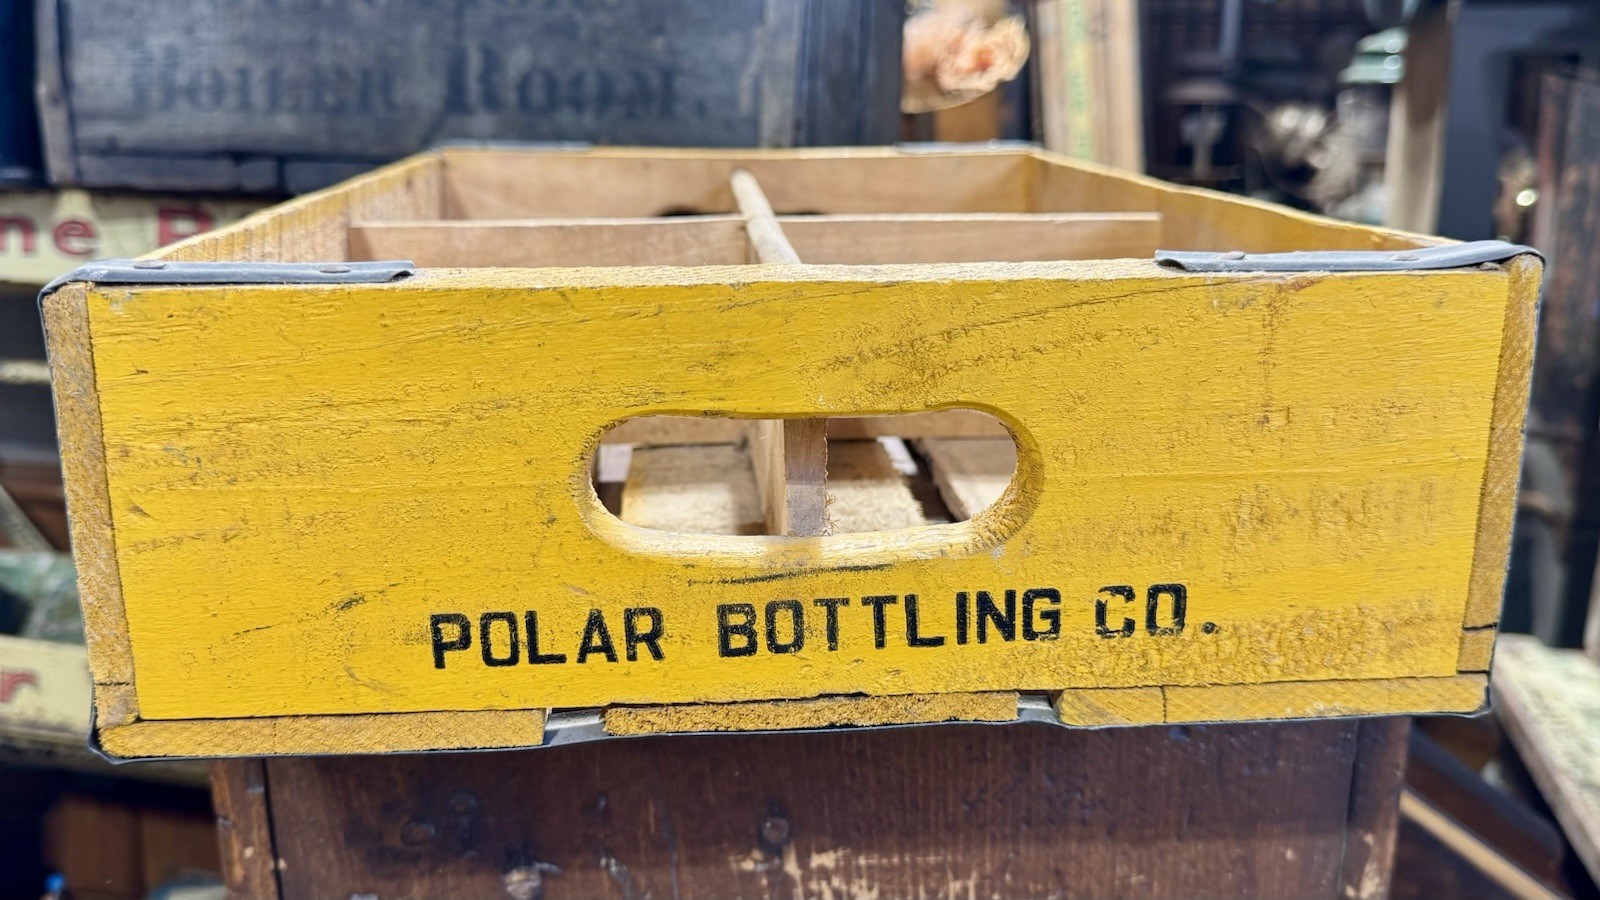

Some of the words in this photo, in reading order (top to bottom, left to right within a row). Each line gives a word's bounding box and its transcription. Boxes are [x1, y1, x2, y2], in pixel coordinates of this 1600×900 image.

[430, 607, 665, 670] POLAR
[717, 587, 1062, 658] BOTTLING
[1094, 583, 1220, 637] CO.
